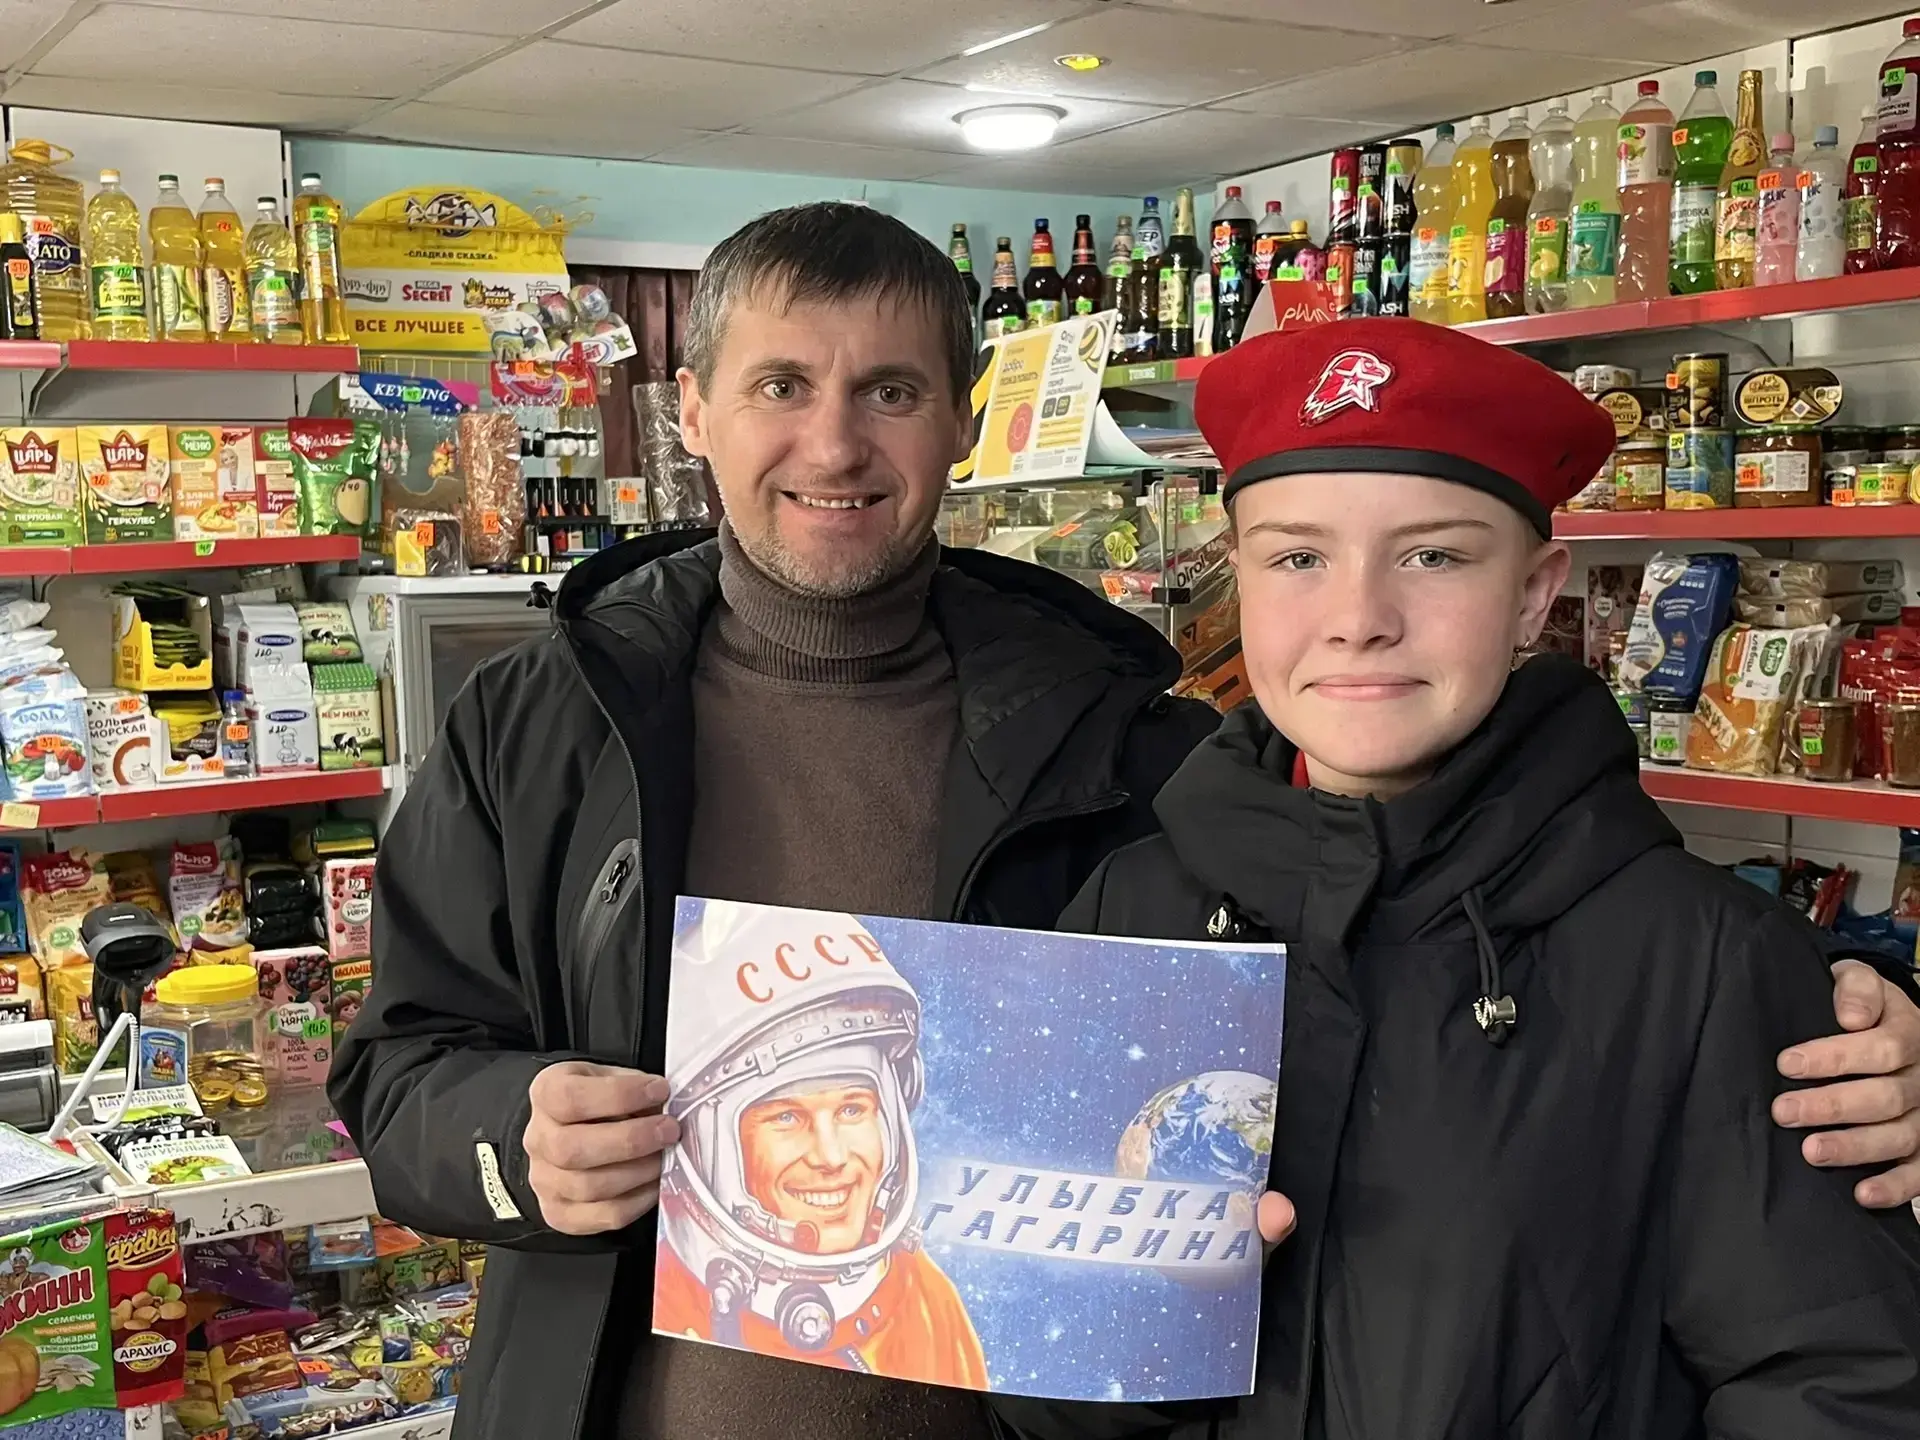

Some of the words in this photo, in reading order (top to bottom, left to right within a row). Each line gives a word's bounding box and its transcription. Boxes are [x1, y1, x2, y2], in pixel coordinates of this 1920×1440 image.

[355, 319, 387, 333] ВСЕ
[394, 320, 465, 334] ЛУЧШЕЕ
[269, 442, 292, 452] МЕН
[14, 449, 54, 466] ЦАРЬ
[106, 448, 145, 463] ЦАРЬ
[15, 513, 63, 521] ПЕРЛОВАЯ
[108, 516, 156, 526] ГЕРКУЛЕС
[1177, 554, 1207, 587] Dirol
[322, 710, 341, 718] NEW
[343, 710, 369, 718] MILKY
[89, 718, 120, 729] СОЛЬ
[90, 723, 147, 739] МОРСКАЯ
[736, 933, 883, 1003] СССР
[100, 1091, 188, 1108] НАТРАЛЬНЫЕ
[134, 1143, 228, 1159] НАТУРАЛЬНЫЕ
[956, 1166, 1231, 1221] УЛЫБКА
[921, 1202, 1251, 1260] ГАГАРИНА
[48, 1313, 95, 1325] семечки
[51, 1333, 96, 1344] обжарки
[120, 1343, 171, 1360] АРАХИС
